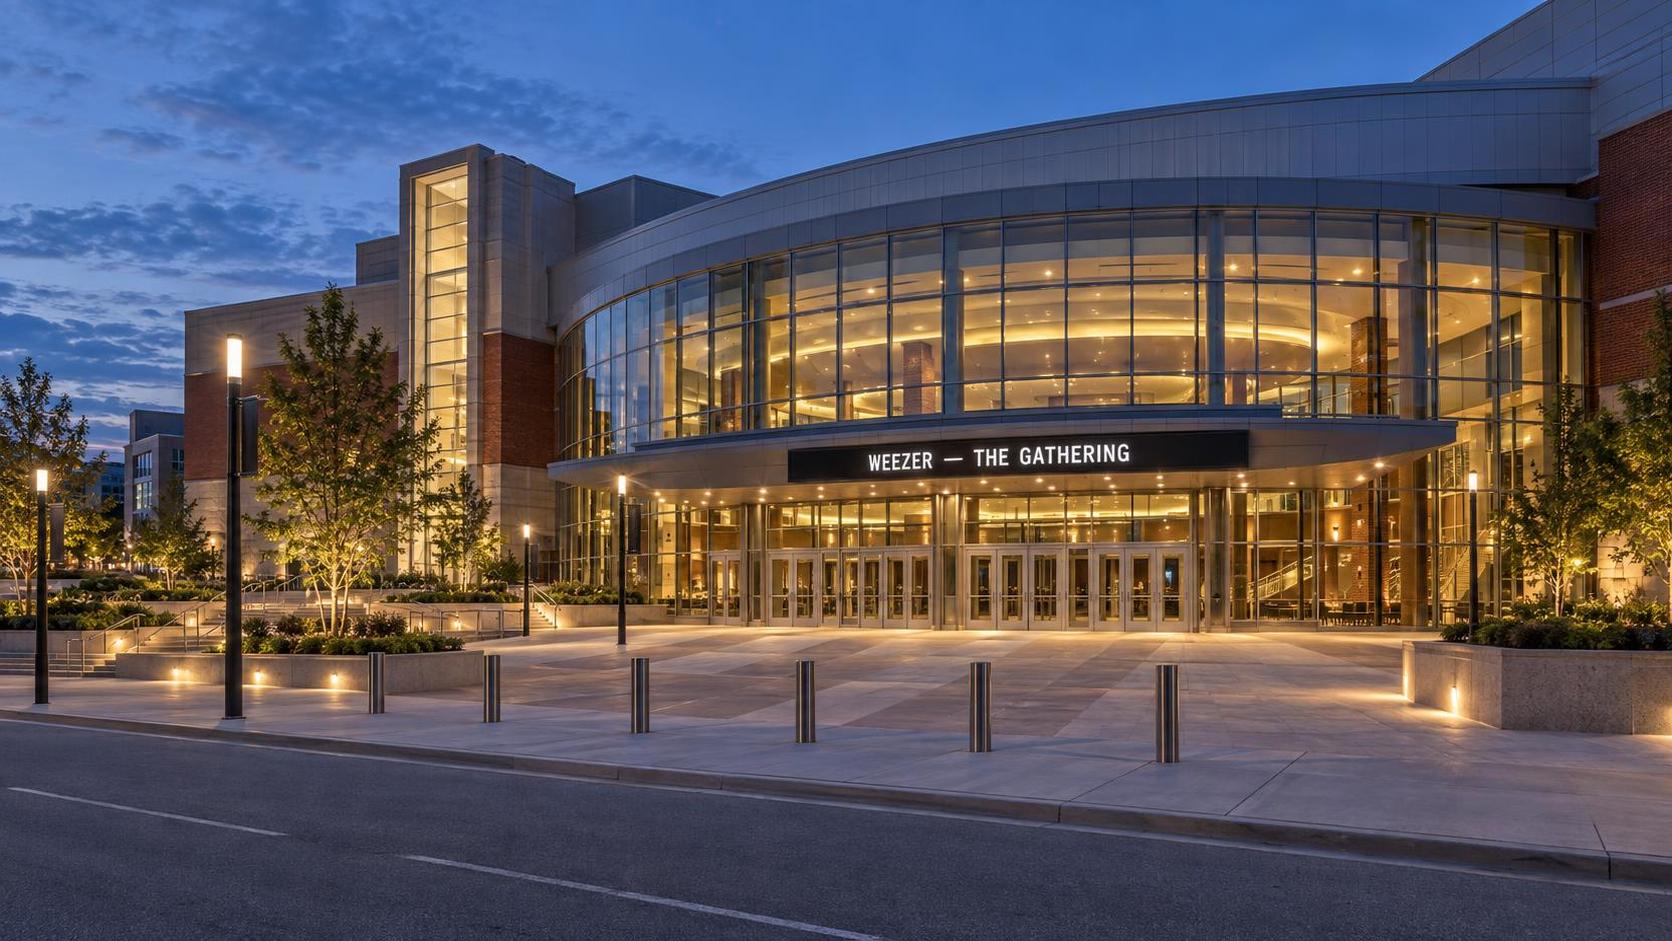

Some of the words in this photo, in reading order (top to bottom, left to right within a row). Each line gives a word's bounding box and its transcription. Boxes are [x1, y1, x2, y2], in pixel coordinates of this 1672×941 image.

[868, 452, 933, 472] WEEZER
[974, 448, 1010, 467] THE
[1019, 444, 1130, 465] GATHERING
